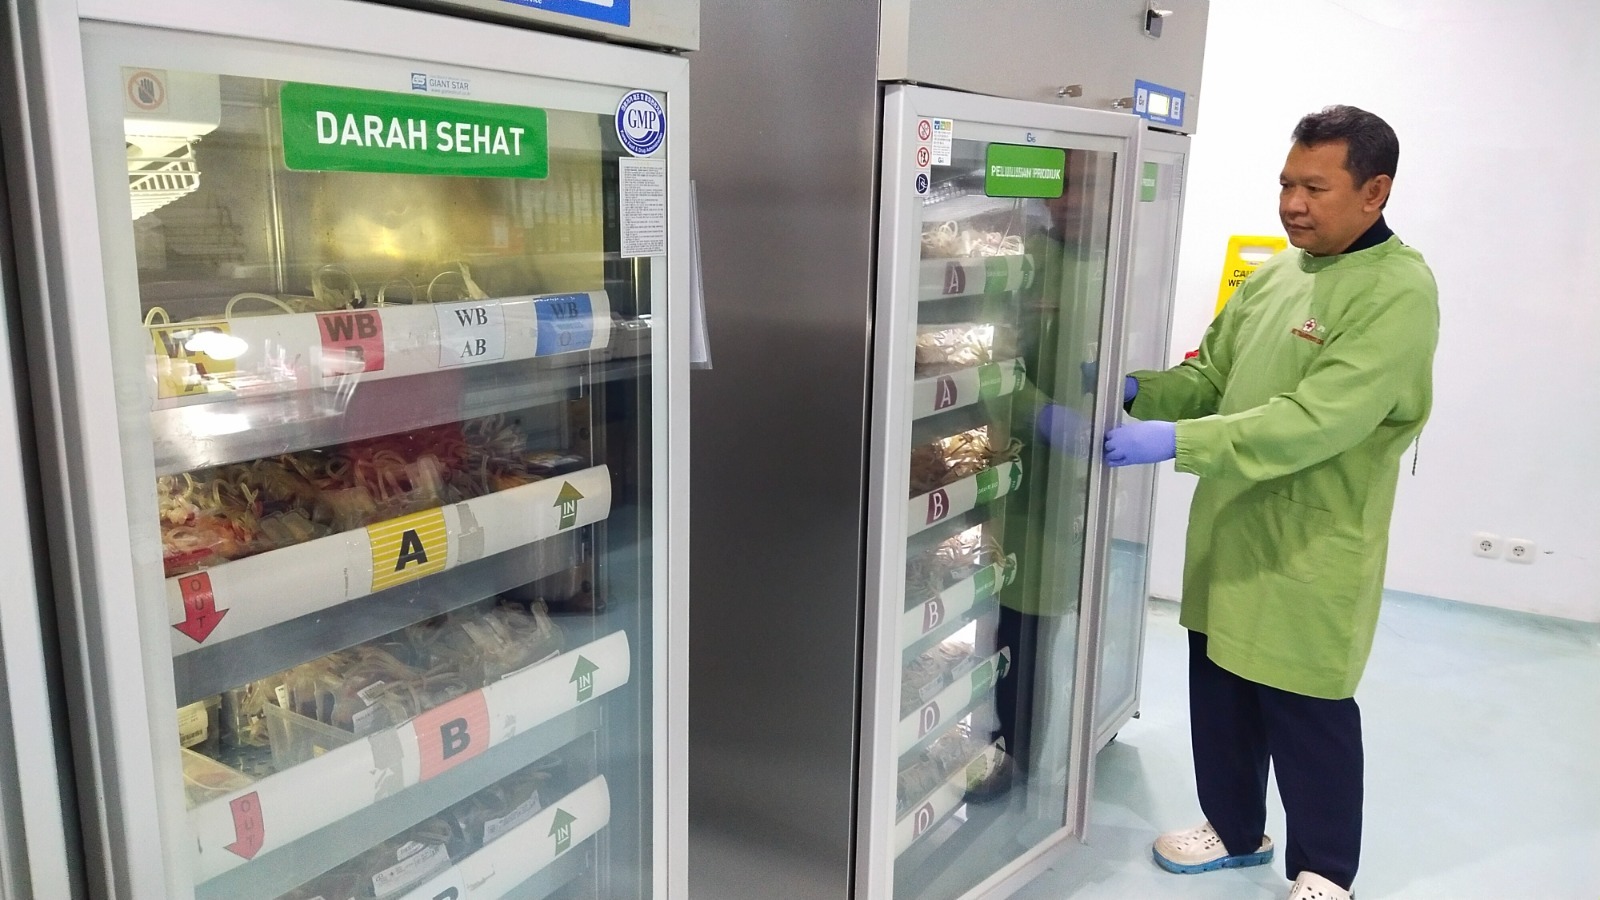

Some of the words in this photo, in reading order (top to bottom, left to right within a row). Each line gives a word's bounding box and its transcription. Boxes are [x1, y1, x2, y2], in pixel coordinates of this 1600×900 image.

[430, 79, 450, 88] GIANT
[451, 81, 469, 90] STAR
[627, 108, 656, 130] GMP
[316, 110, 427, 150] DARAH
[436, 121, 524, 156] SEHAT
[1033, 168, 1061, 180] PRODUK
[948, 266, 961, 294] A
[455, 307, 488, 328] WB
[551, 302, 578, 319] WB
[322, 313, 378, 342] WB
[460, 338, 487, 359] AB
[940, 380, 951, 408] A
[563, 500, 575, 515] IN
[933, 491, 943, 521] B
[394, 529, 428, 572] A
[928, 601, 939, 629] B
[579, 672, 591, 689] IN
[440, 717, 471, 760] B
[557, 824, 569, 842] IN
